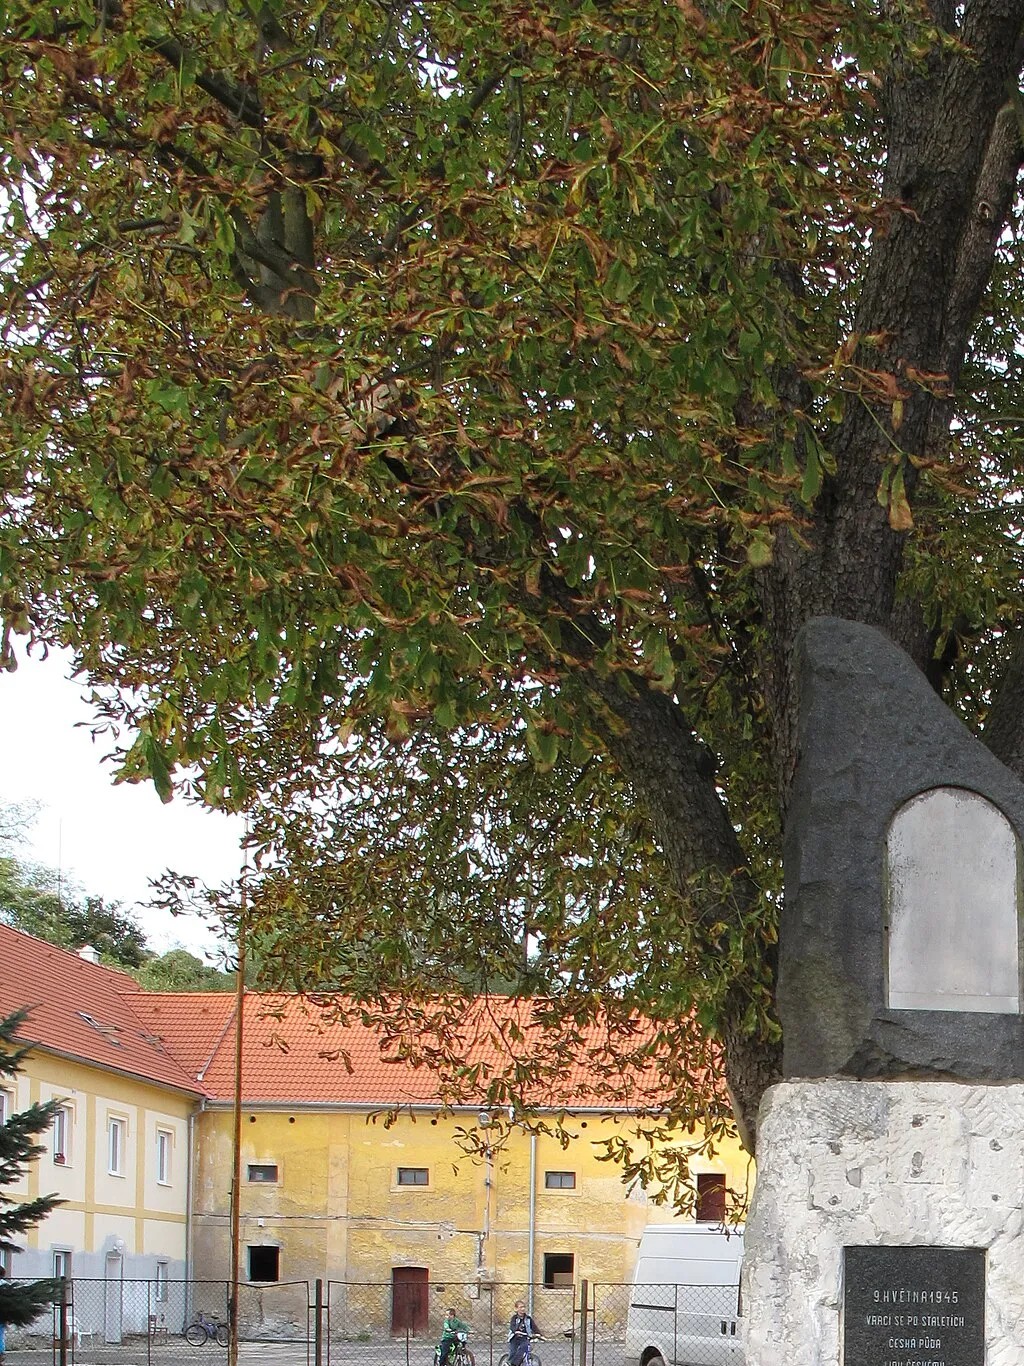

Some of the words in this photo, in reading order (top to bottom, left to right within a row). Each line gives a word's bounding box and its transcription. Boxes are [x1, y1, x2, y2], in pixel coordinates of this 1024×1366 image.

[929, 1291, 959, 1304] 1945
[894, 1316, 904, 1326] SE
[907, 1315, 918, 1326] PO
